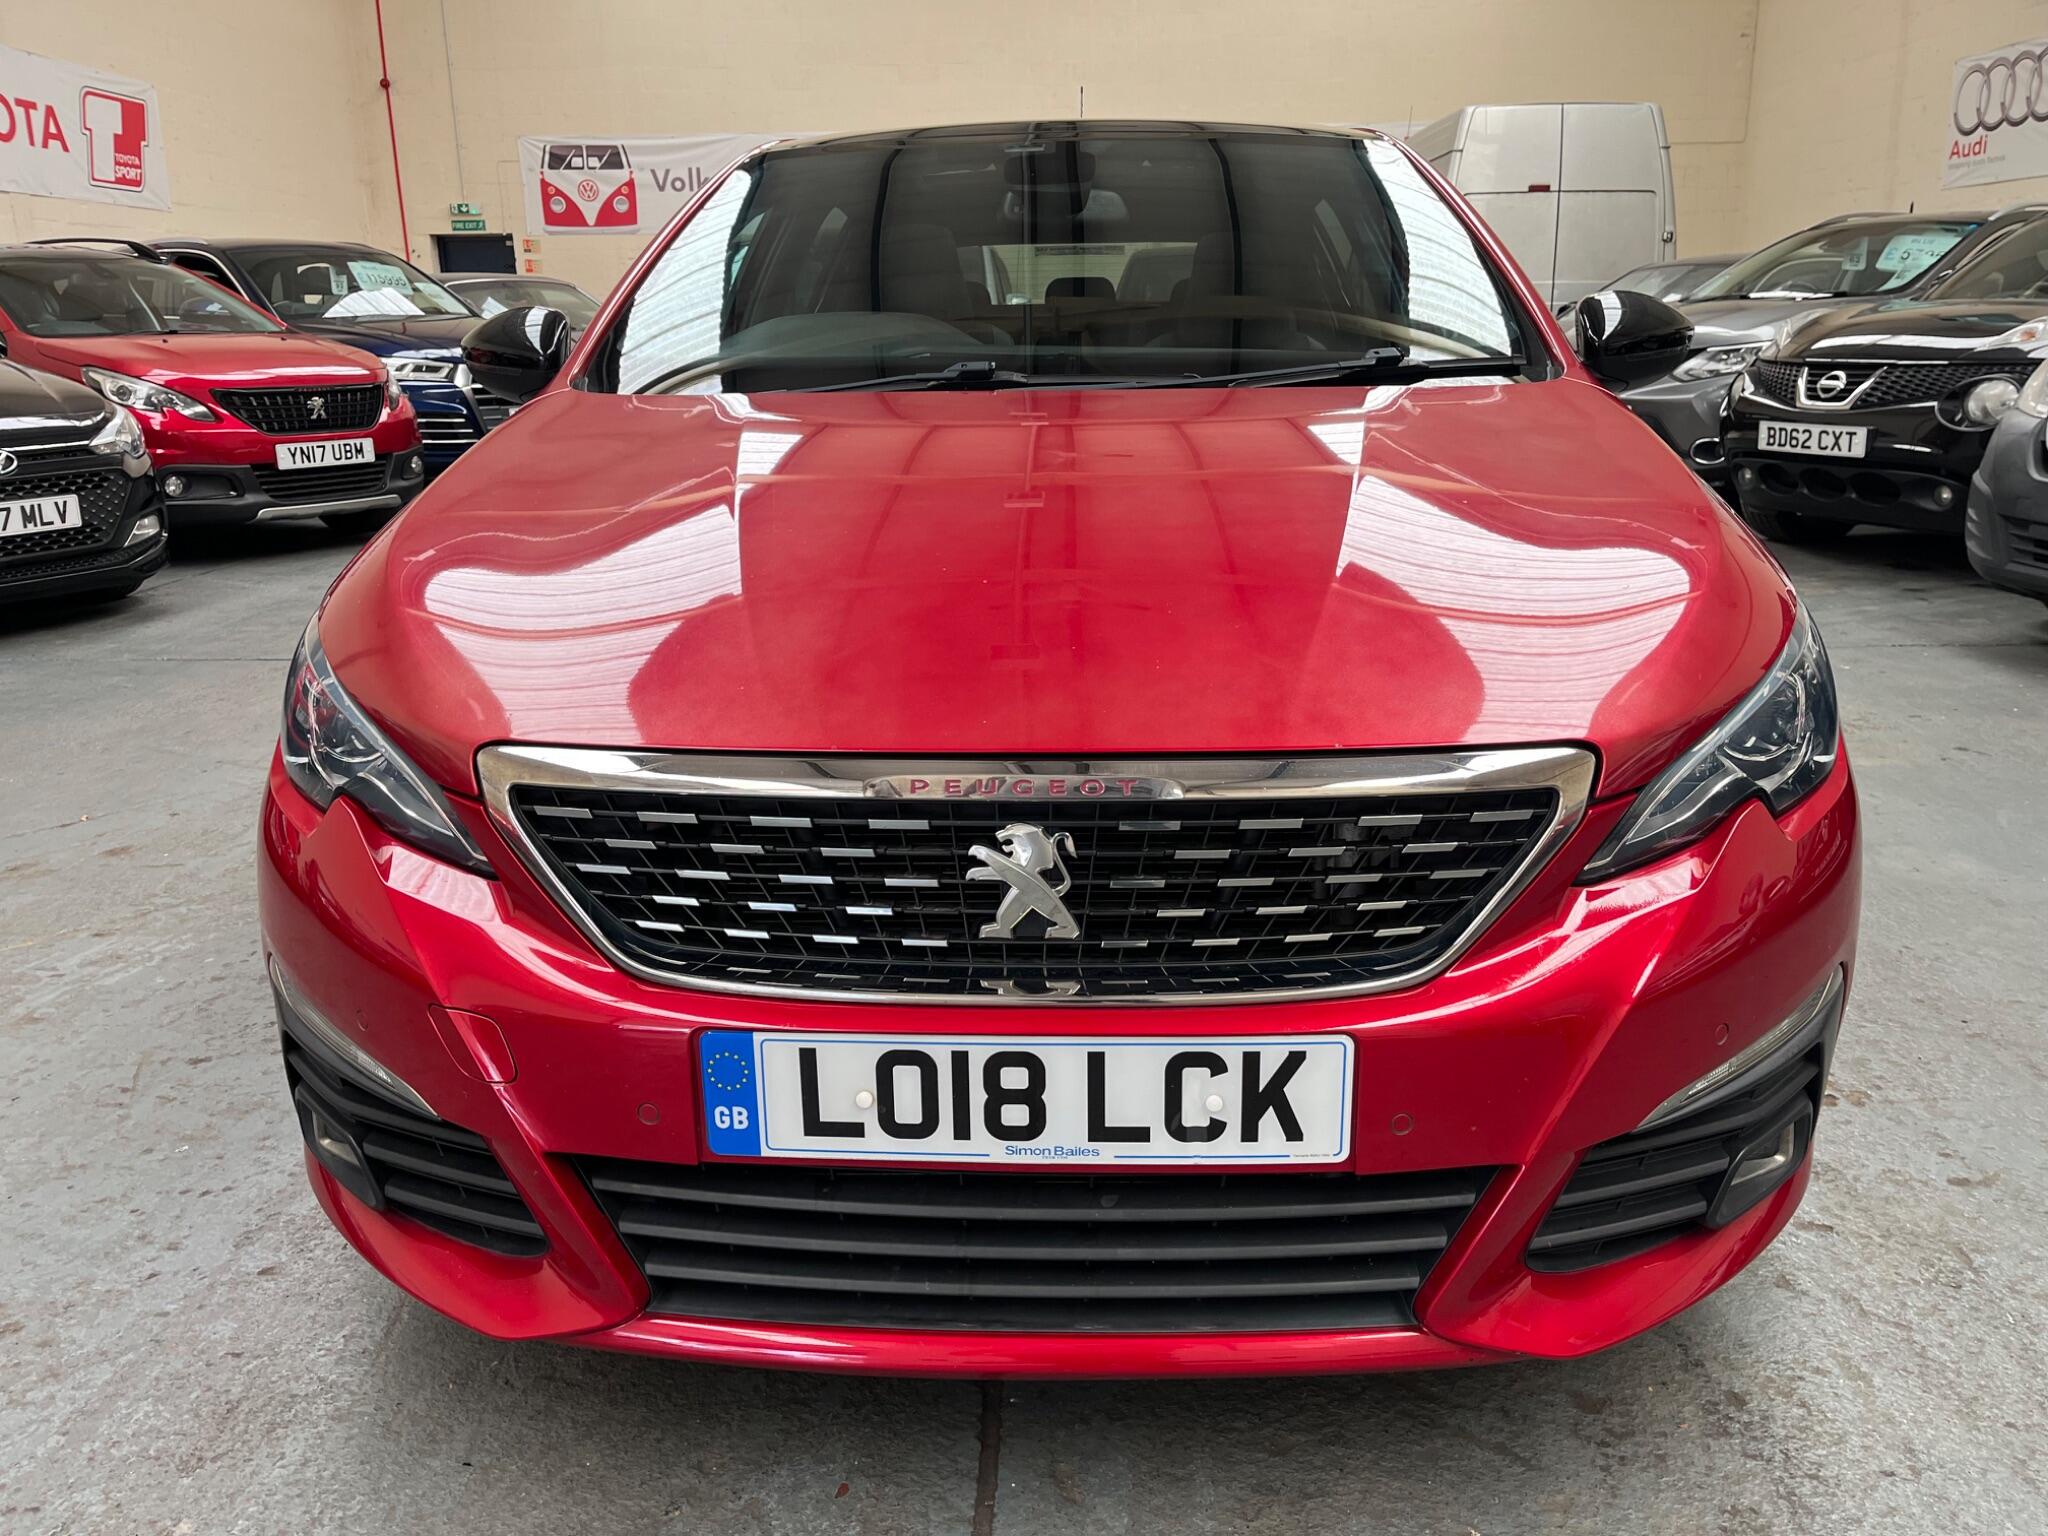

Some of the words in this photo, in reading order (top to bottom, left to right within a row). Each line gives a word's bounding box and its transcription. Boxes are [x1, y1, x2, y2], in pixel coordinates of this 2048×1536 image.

[1948, 134, 1989, 160] Audi
[114, 153, 140, 165] TOYOTA
[114, 165, 141, 181] SPORT
[1766, 427, 1812, 449] BD62
[1818, 430, 1857, 452] CXT
[287, 445, 326, 464] YN17
[331, 442, 365, 461] UBM
[20, 500, 67, 529] MLV
[909, 778, 1139, 798] PEUGEOT
[798, 1047, 1046, 1142] LO18
[1087, 1050, 1307, 1143] LCK
[714, 1106, 749, 1130] GB
[1005, 1145, 1052, 1156] Simon
[1054, 1146, 1100, 1157] Bailes
